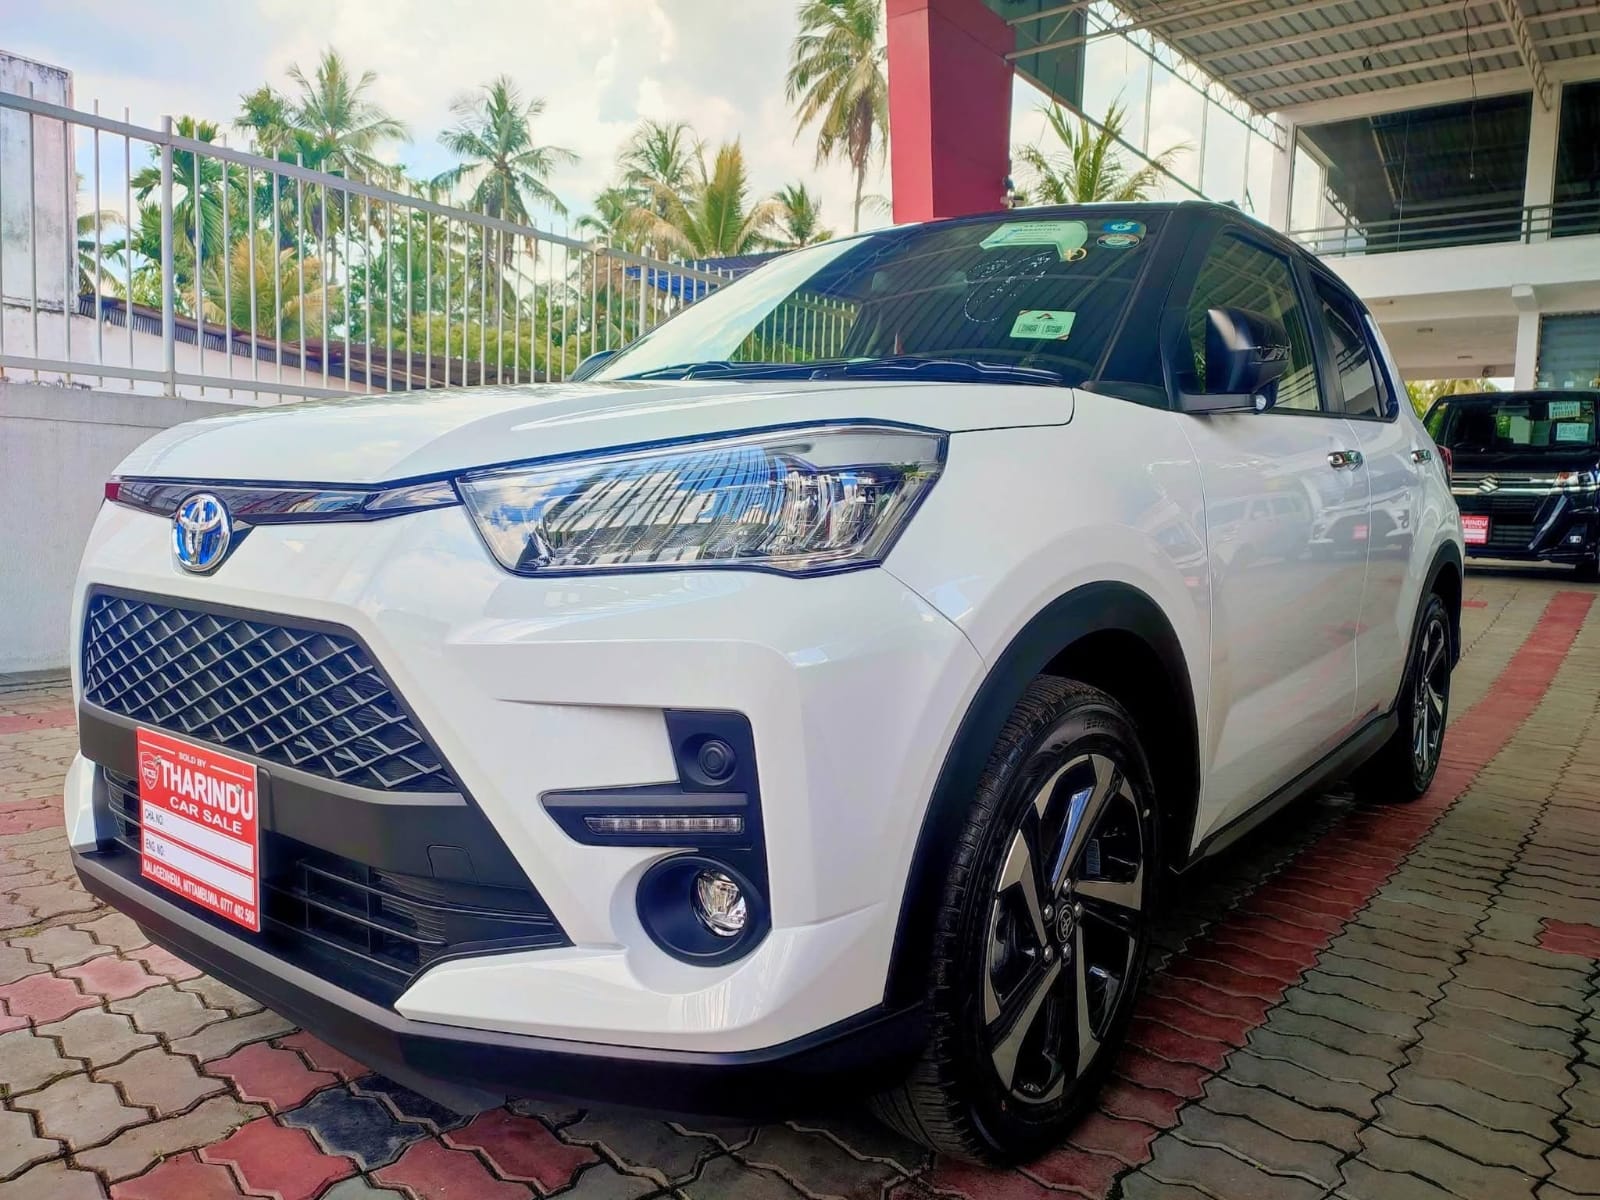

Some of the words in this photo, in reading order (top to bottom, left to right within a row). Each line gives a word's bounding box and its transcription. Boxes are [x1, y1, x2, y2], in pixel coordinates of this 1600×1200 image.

[179, 751, 197, 765] SOLD
[197, 758, 207, 768] BY
[160, 758, 253, 821] THARINDU
[169, 796, 200, 819] CAR
[202, 809, 242, 836] SALE
